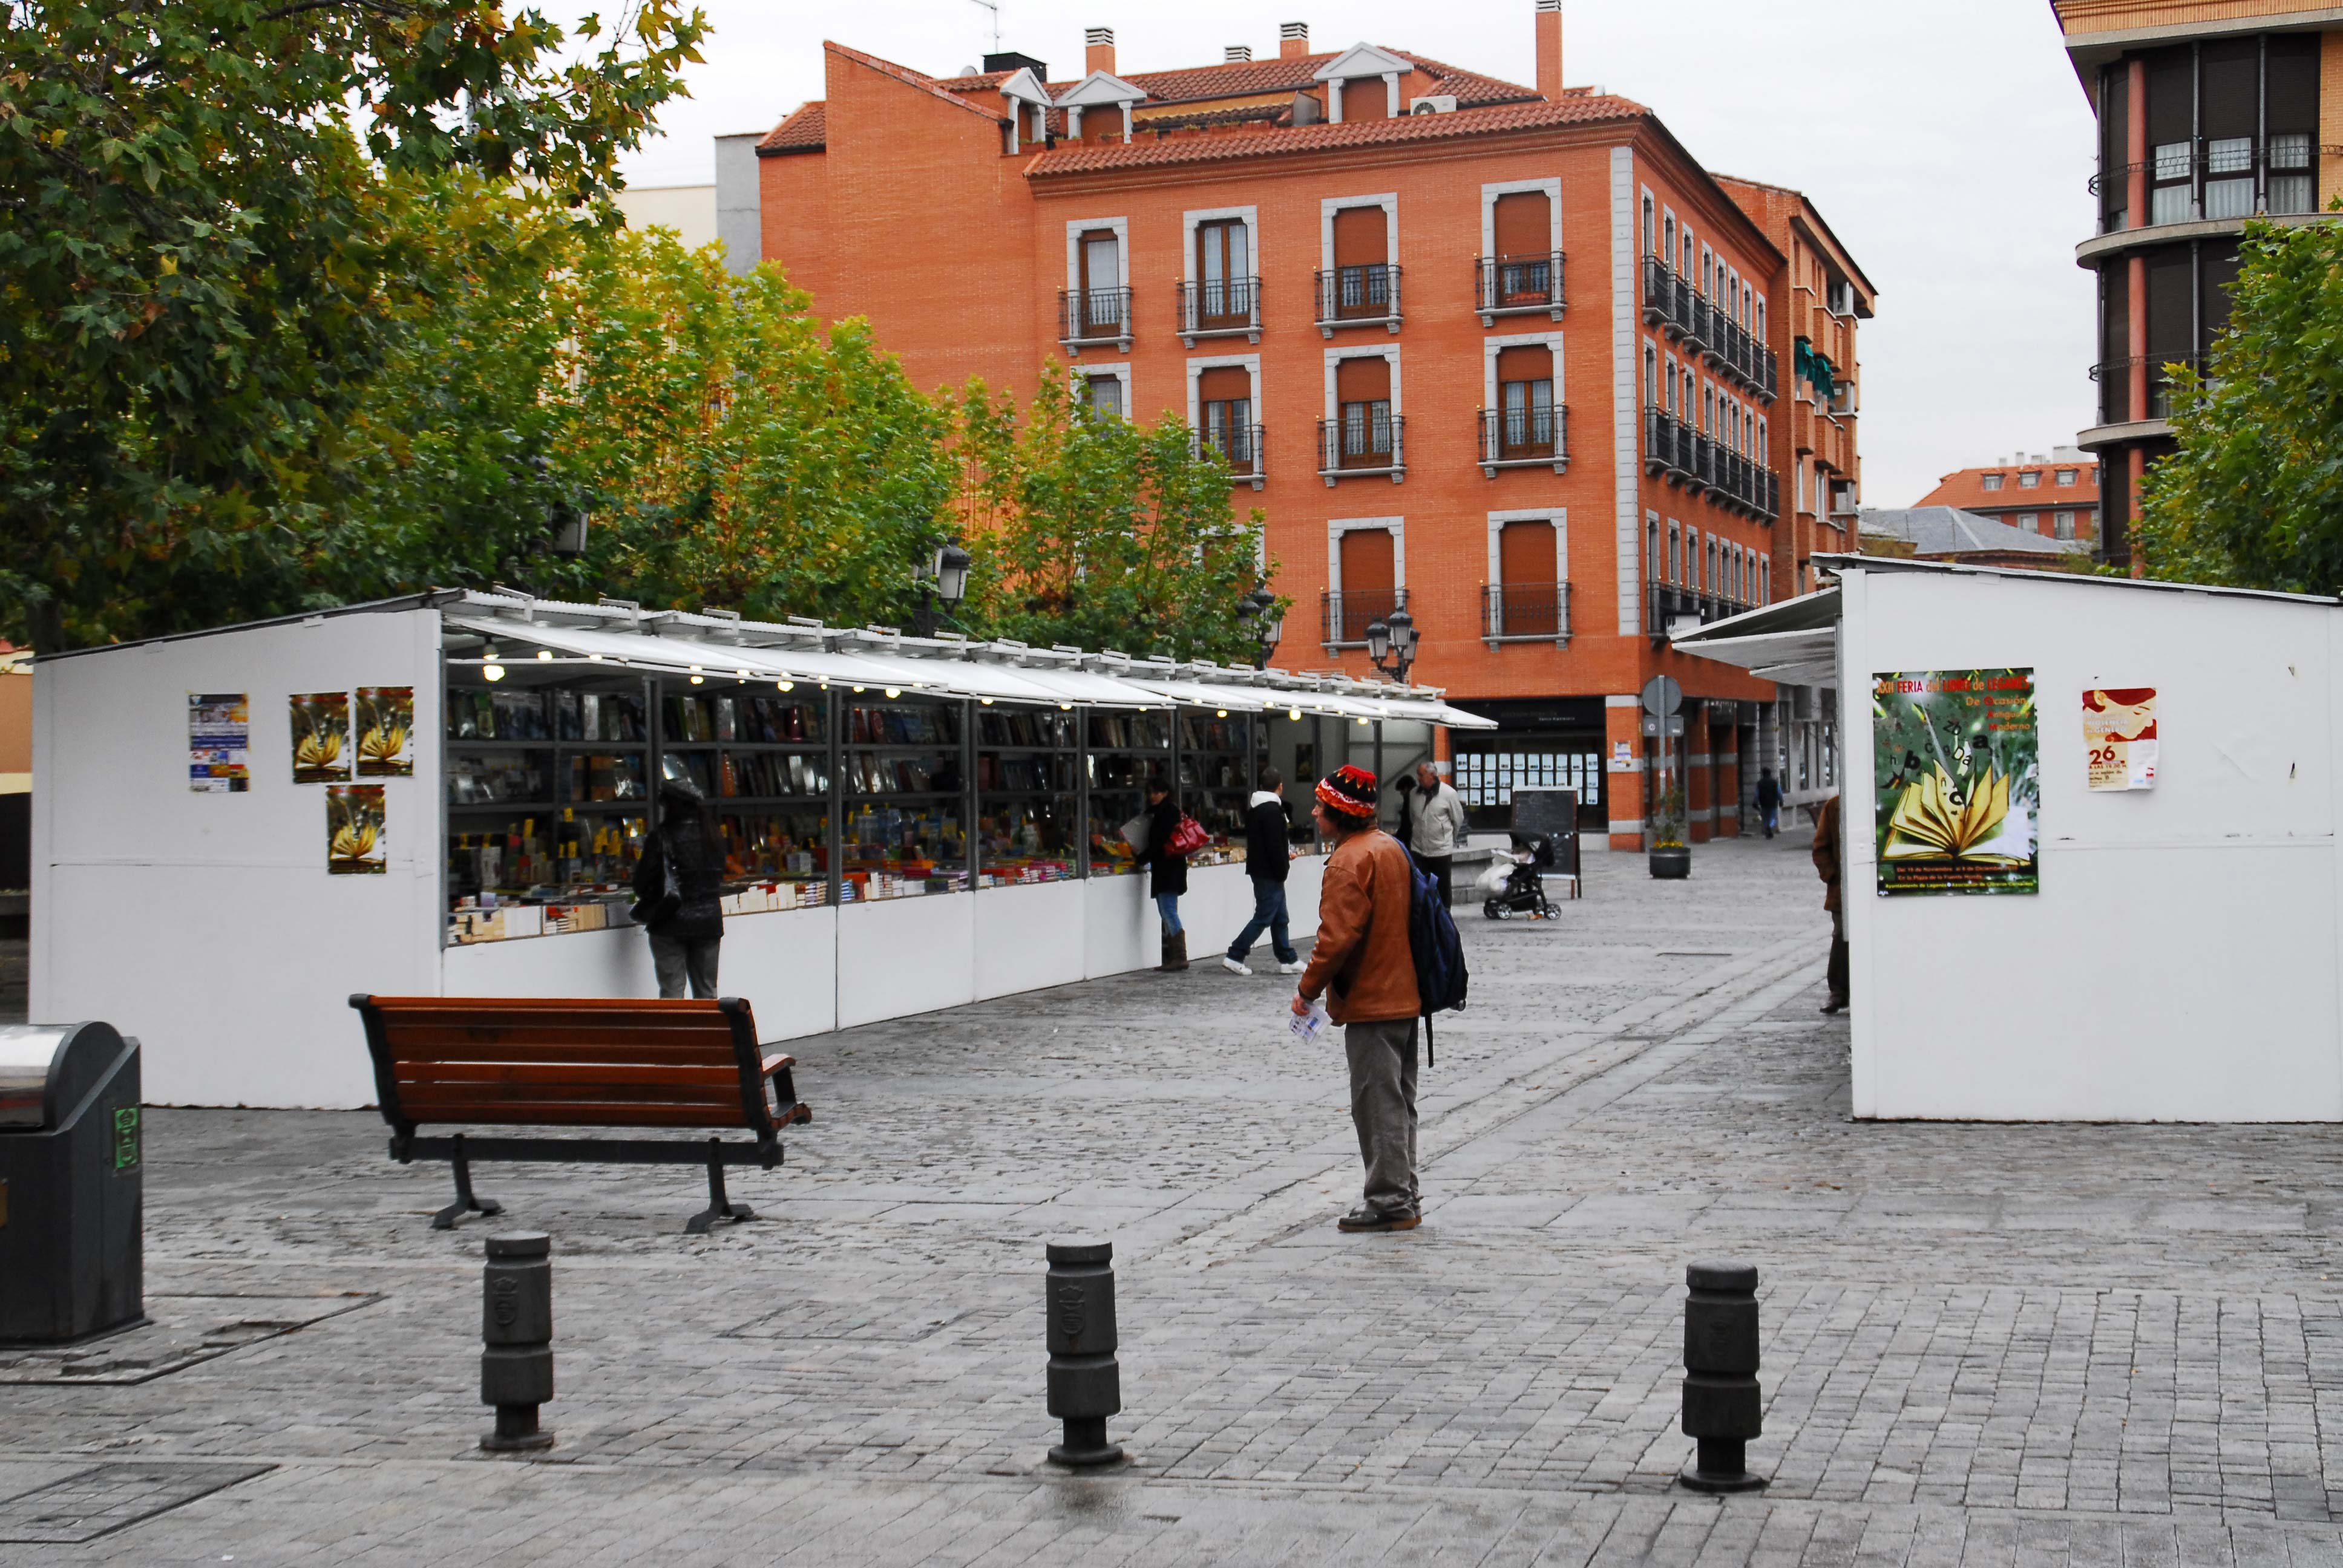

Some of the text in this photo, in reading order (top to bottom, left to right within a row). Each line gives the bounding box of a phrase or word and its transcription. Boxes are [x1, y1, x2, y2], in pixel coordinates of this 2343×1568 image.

[1876, 675, 2029, 694] XXII FERIA del LIBRO de LEGANÉS
[1966, 697, 1980, 707] De
[1988, 722, 2030, 731] Moderno
[2089, 745, 2115, 765] 26
